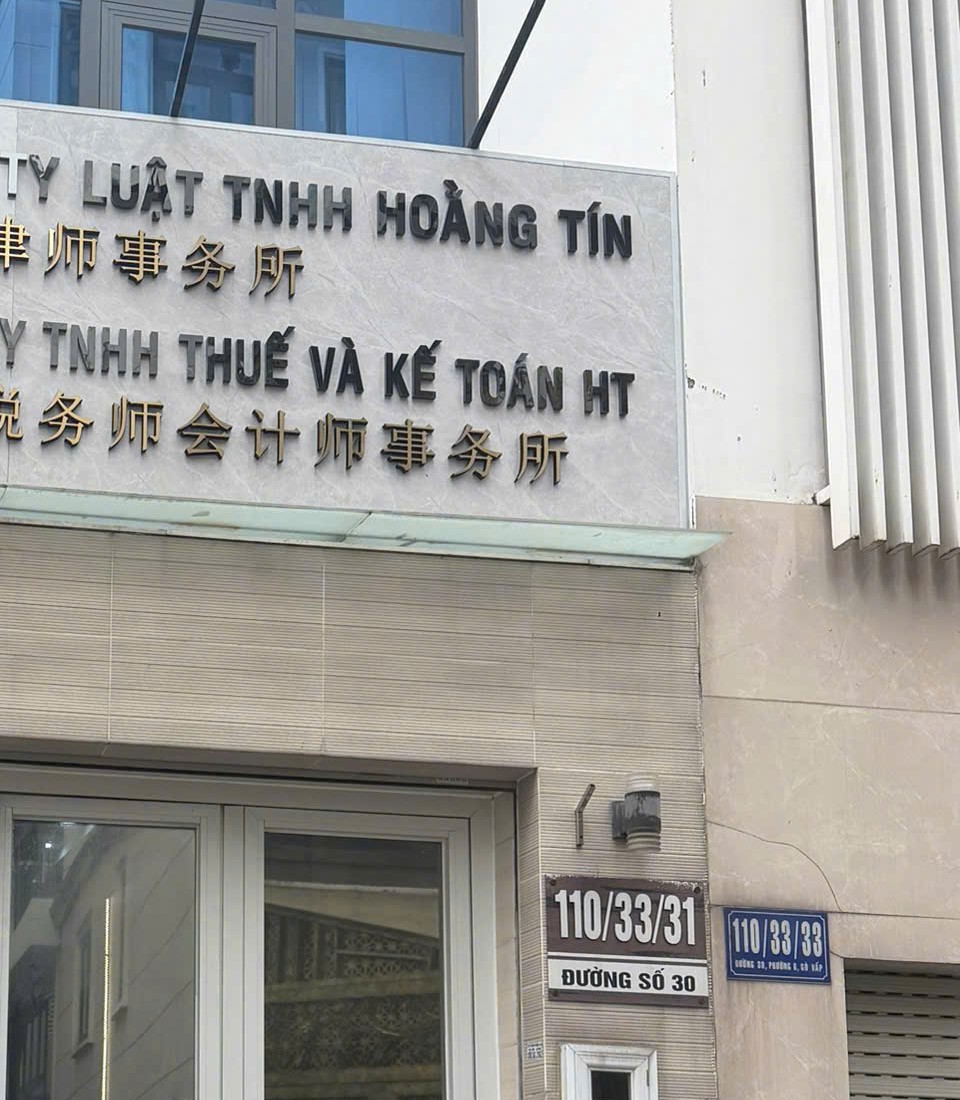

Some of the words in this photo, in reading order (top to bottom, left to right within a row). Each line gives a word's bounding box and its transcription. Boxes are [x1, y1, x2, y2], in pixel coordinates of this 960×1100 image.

[82, 156, 203, 222] LUẬT
[223, 174, 352, 232] TNHH
[557, 201, 632, 260] TÍN
[42, 321, 159, 378] TNHH
[178, 325, 296, 388] THUẾ
[309, 337, 364, 393] VÀ
[384, 340, 442, 401] KẾ
[455, 352, 563, 412] TOÁN
[583, 369, 635, 417] HT
[555, 889, 696, 945] 110/33/31
[732, 918, 822, 959] 110/33/33
[561, 968, 631, 990] ĐƯỜNG
[638, 968, 665, 991] SỐ
[672, 975, 696, 992] 30
